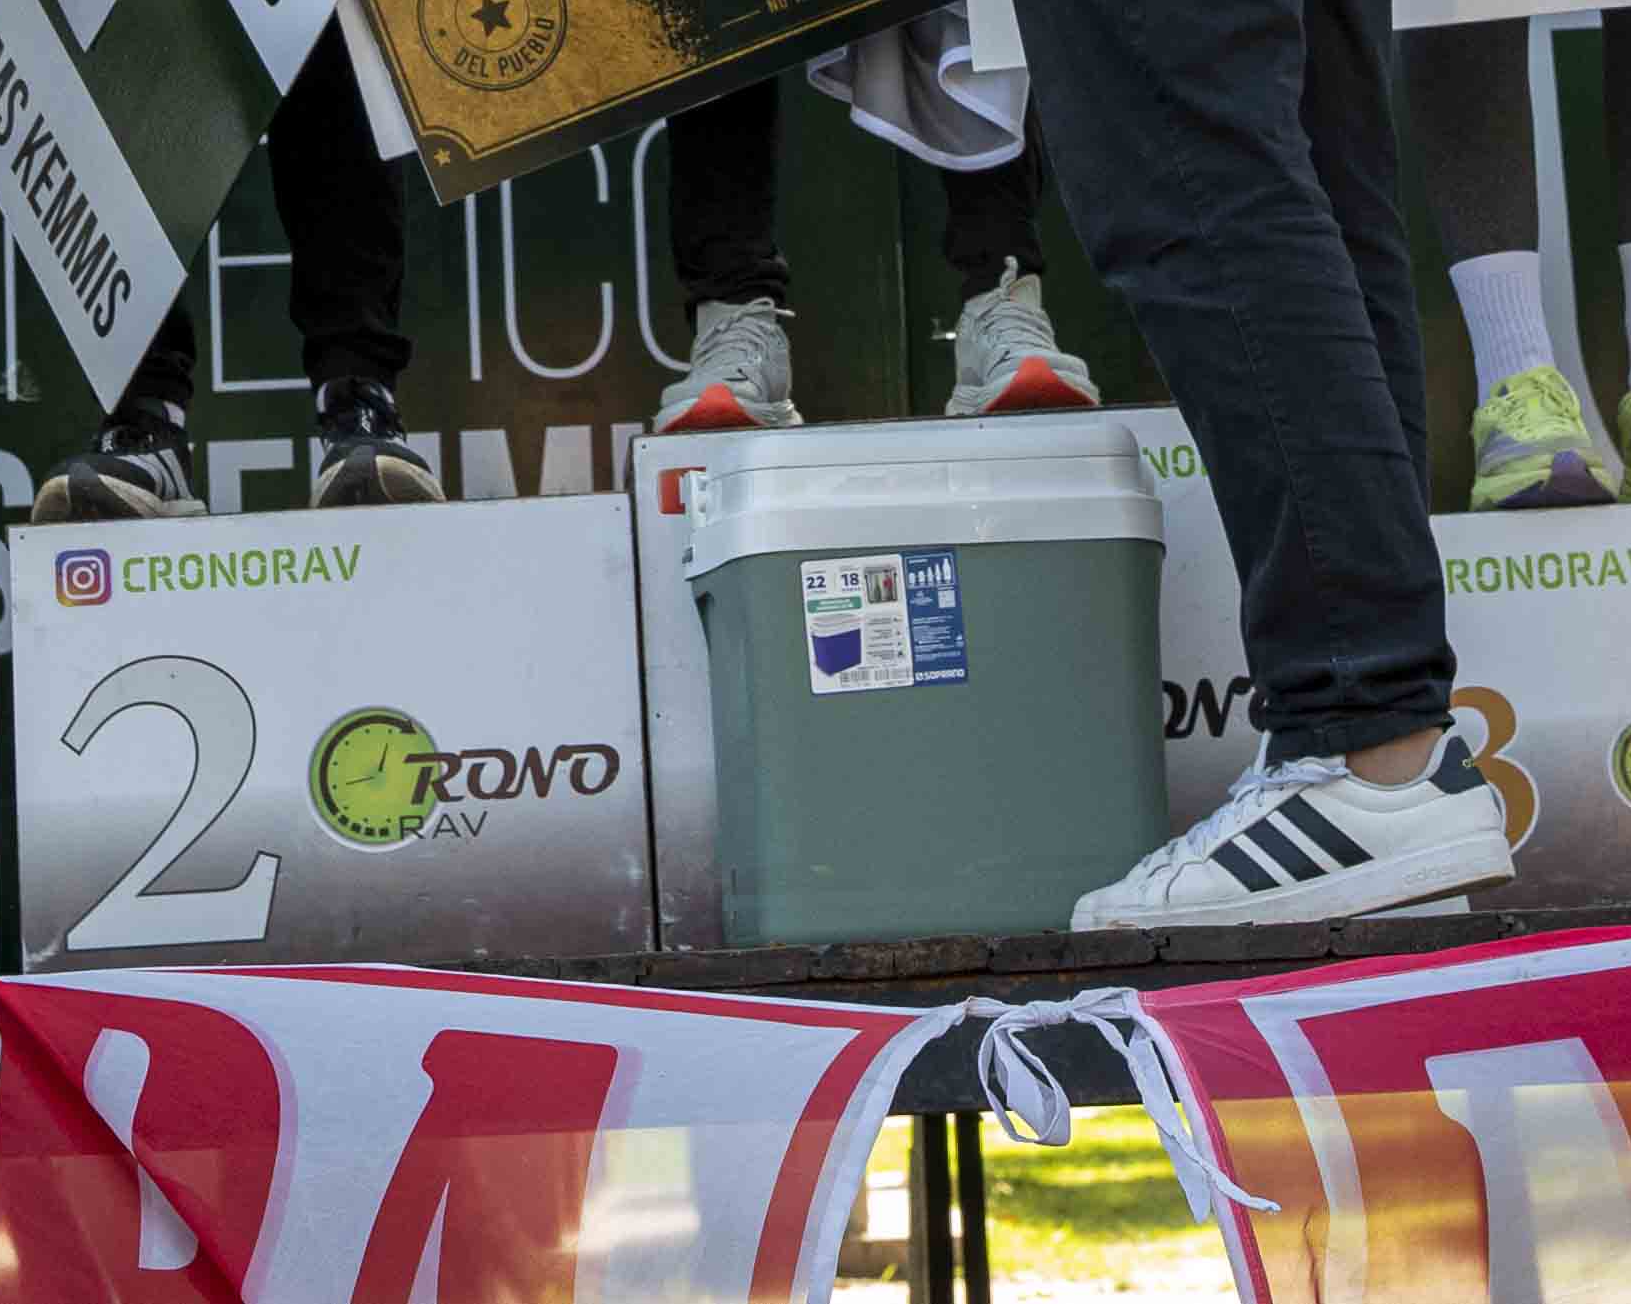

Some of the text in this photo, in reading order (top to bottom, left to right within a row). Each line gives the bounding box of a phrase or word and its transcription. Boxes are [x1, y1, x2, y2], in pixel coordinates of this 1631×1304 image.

[454, 17, 554, 78] DEL PUEBLO
[10, 113, 133, 340] KEMMIS
[121, 545, 362, 595] CRONORAV
[806, 573, 860, 589] 22 18
[59, 653, 283, 952] 2
[399, 812, 489, 842] RAV
